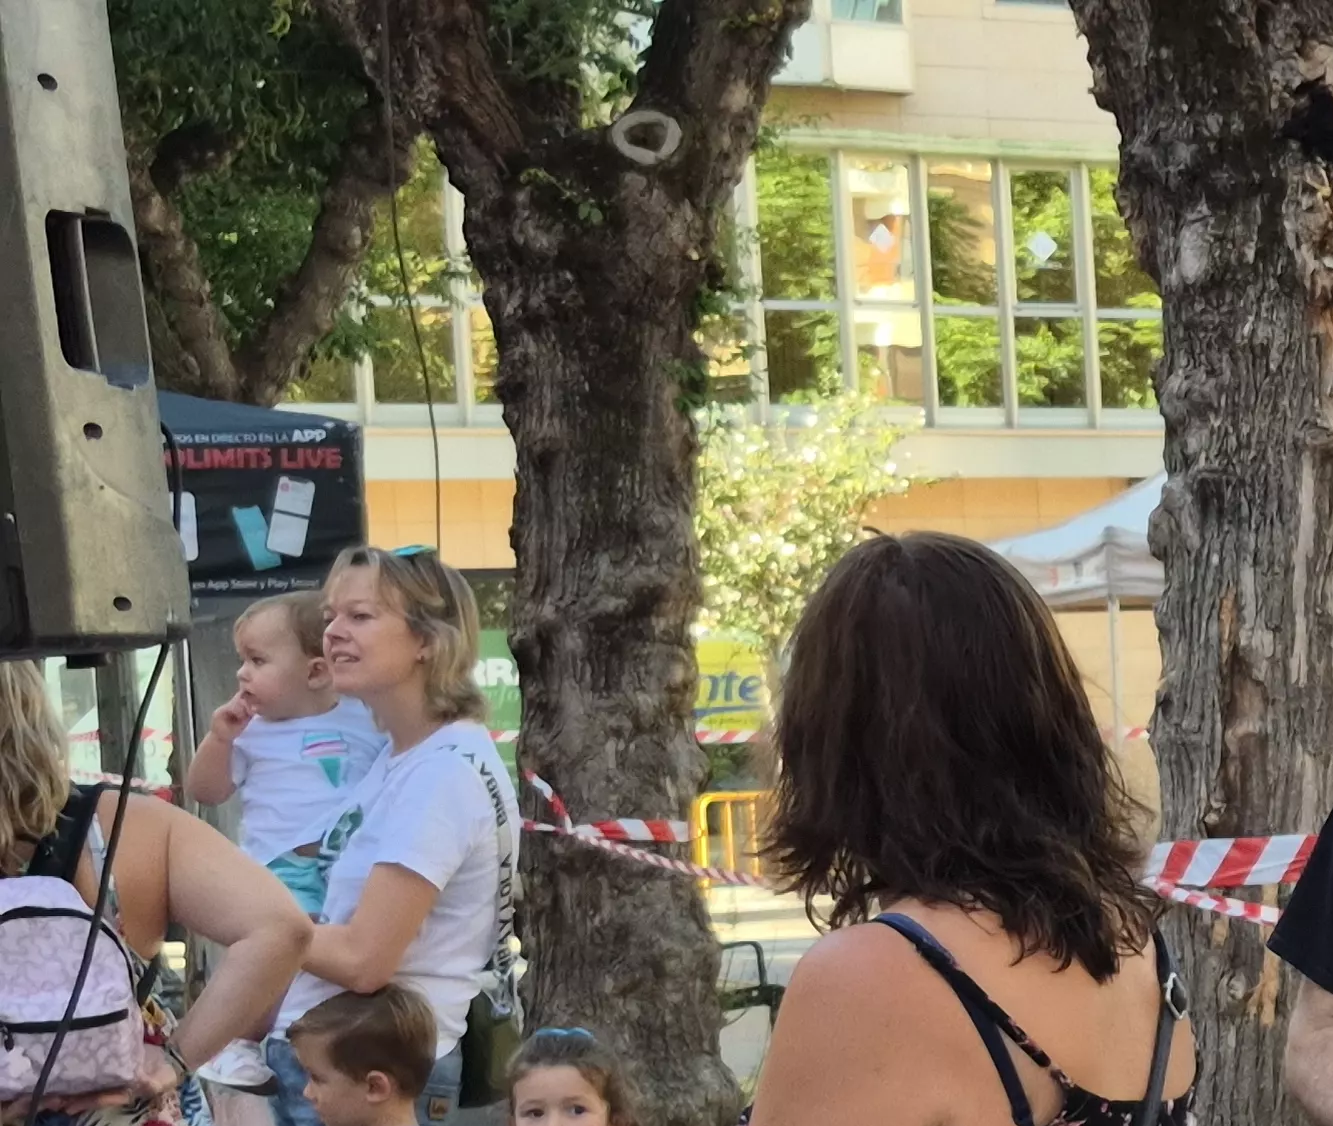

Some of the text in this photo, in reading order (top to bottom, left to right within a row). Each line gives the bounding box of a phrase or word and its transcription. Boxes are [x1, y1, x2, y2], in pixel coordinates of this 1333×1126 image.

[292, 428, 327, 443] APP
[164, 447, 343, 469] OLIMITS LIVE
